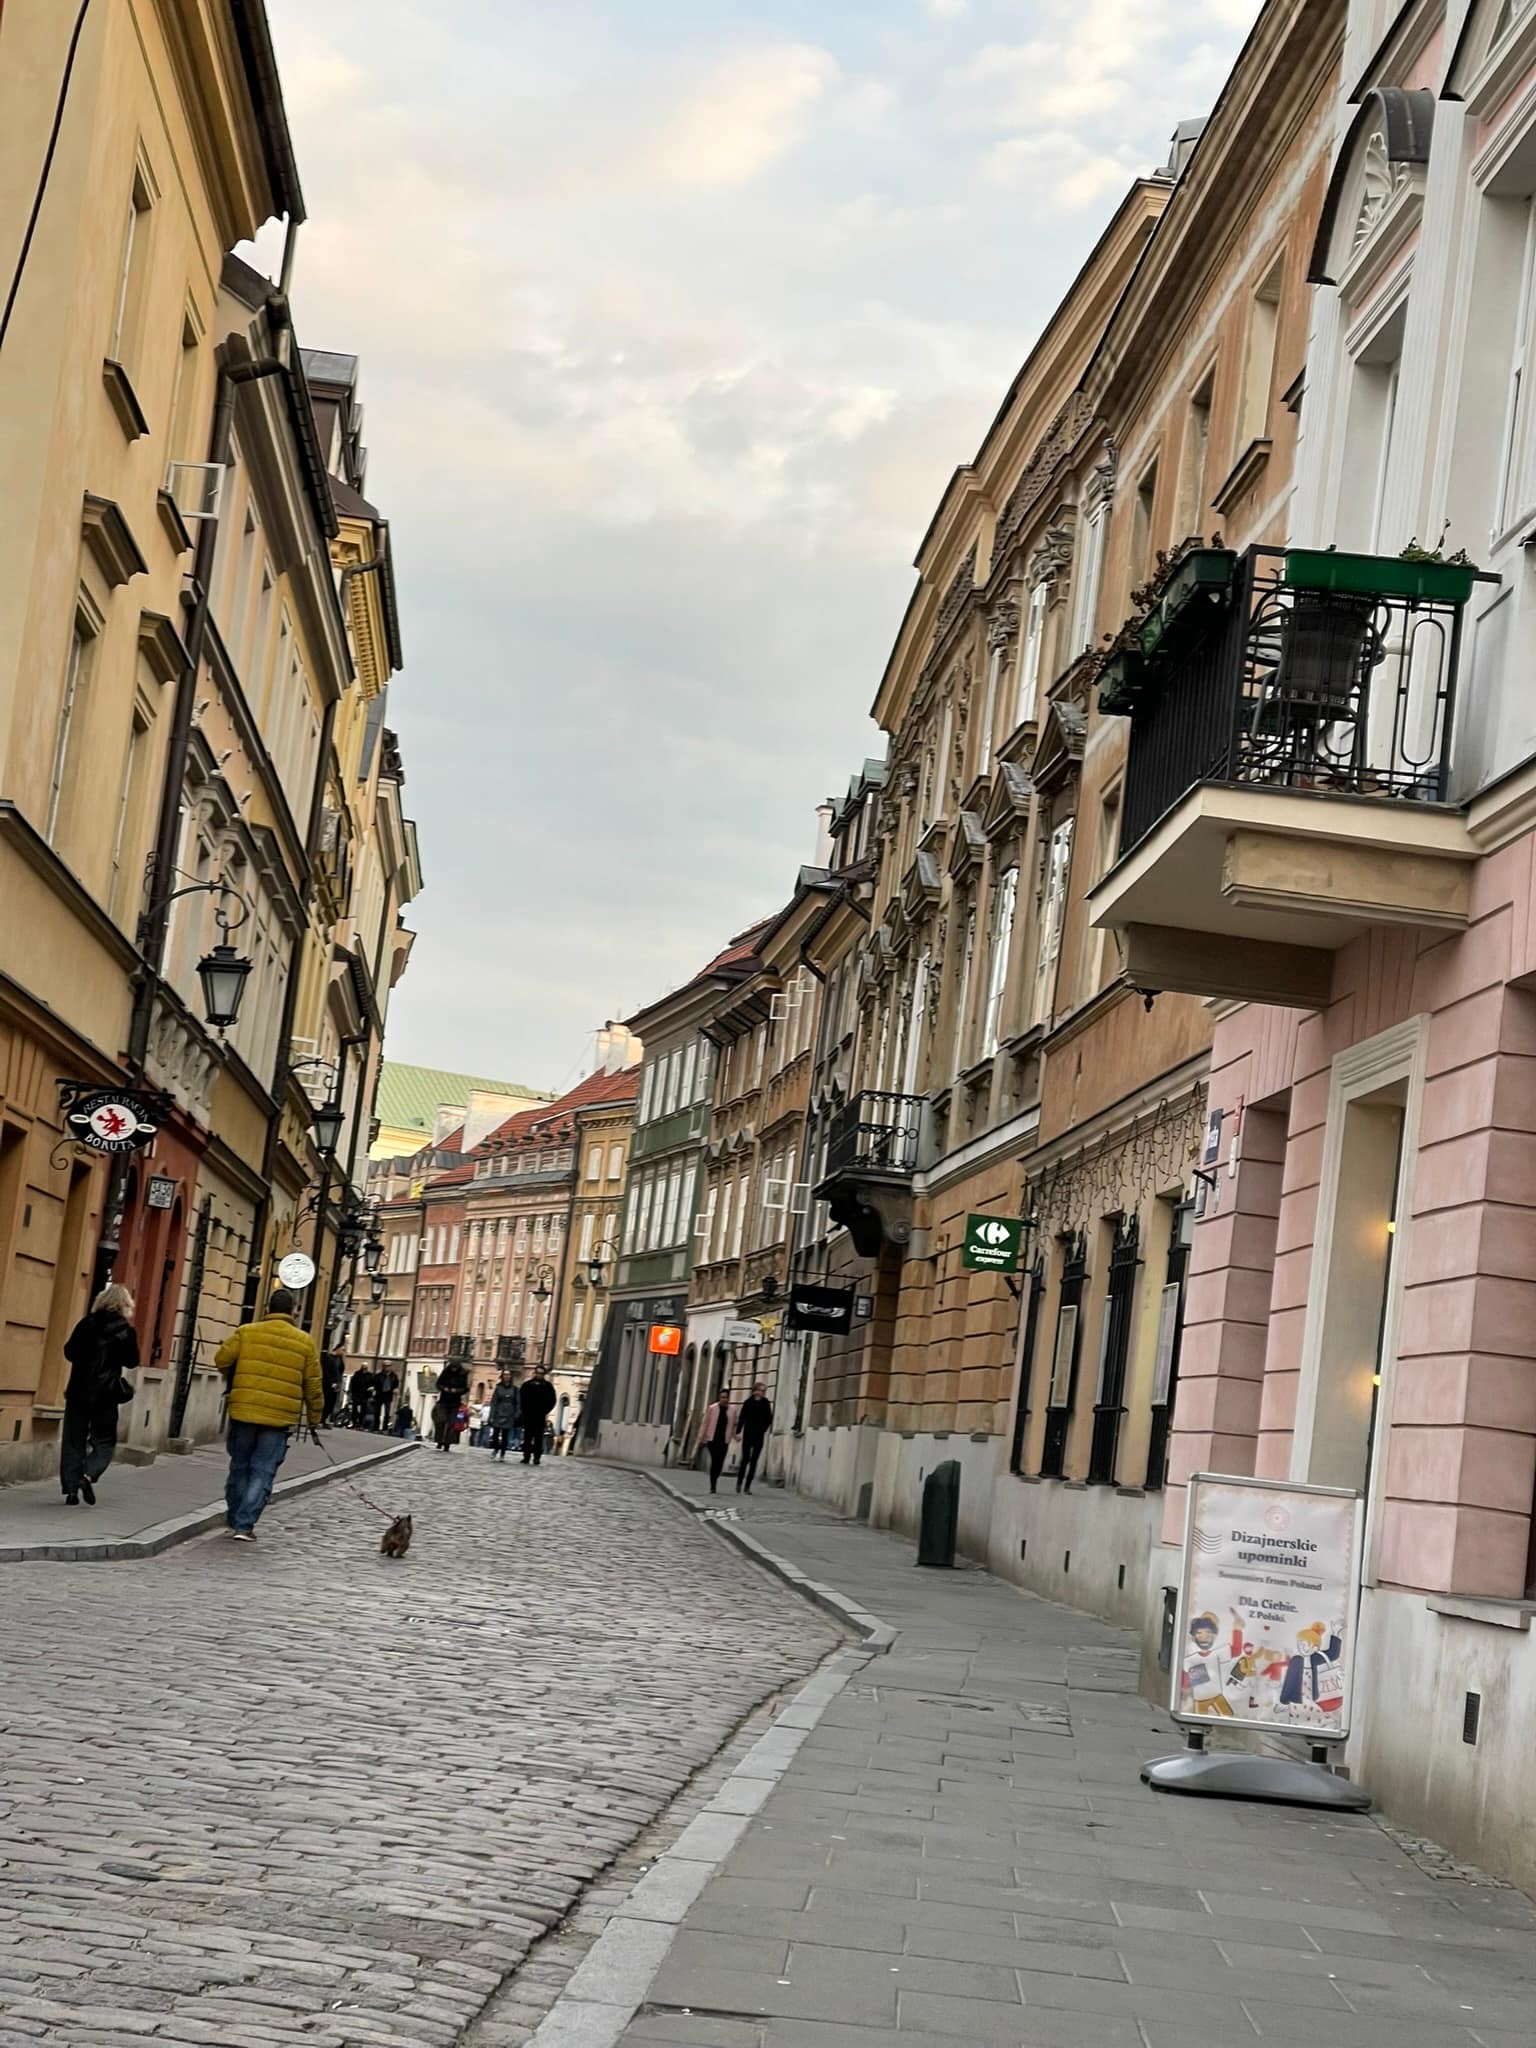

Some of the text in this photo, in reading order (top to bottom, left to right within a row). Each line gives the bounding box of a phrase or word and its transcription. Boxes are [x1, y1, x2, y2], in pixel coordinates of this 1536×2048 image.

[84, 1133, 136, 1151] BORUTA
[970, 1245, 1012, 1257] Carrefour
[1231, 1530, 1317, 1552] Dizajnerskie
[1238, 1551, 1307, 1568] upominki
[1239, 1596, 1258, 1607] Dla
